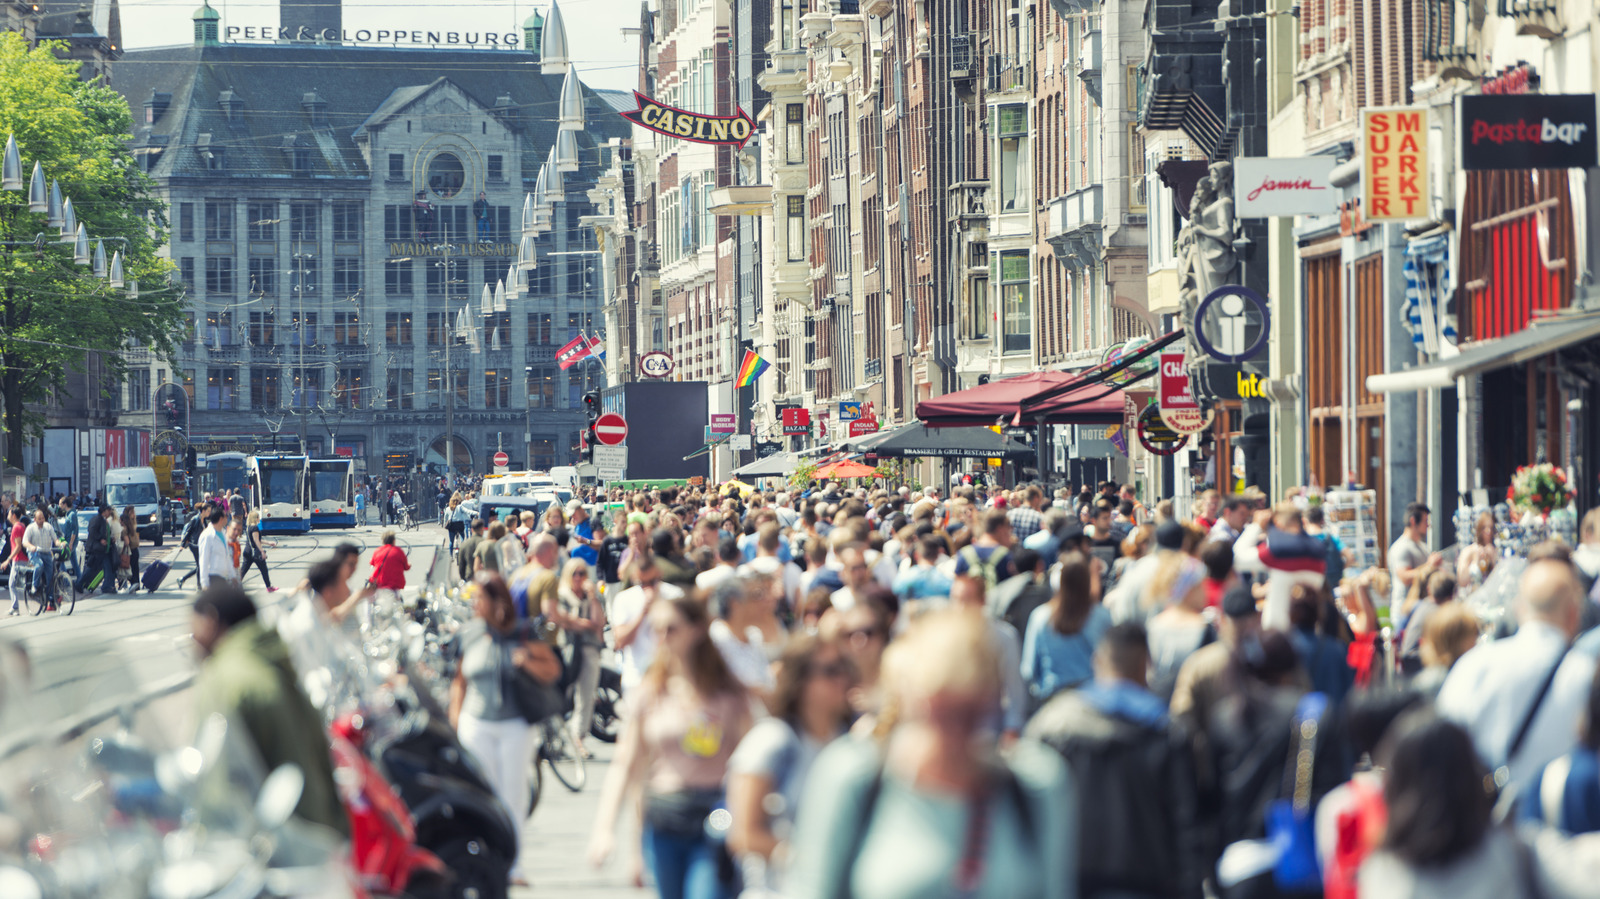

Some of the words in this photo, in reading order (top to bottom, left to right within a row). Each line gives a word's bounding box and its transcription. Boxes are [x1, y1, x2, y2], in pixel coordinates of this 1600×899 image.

[227, 26, 291, 40] PEEK
[320, 28, 519, 45] CLOPPENBURG
[641, 104, 750, 140] CASINO
[1369, 114, 1391, 217] SUPER
[1397, 113, 1420, 215] MARKT
[1247, 175, 1326, 202] jamin
[645, 358, 669, 371] C&A
[963, 449, 1005, 457] RESTAURANT
